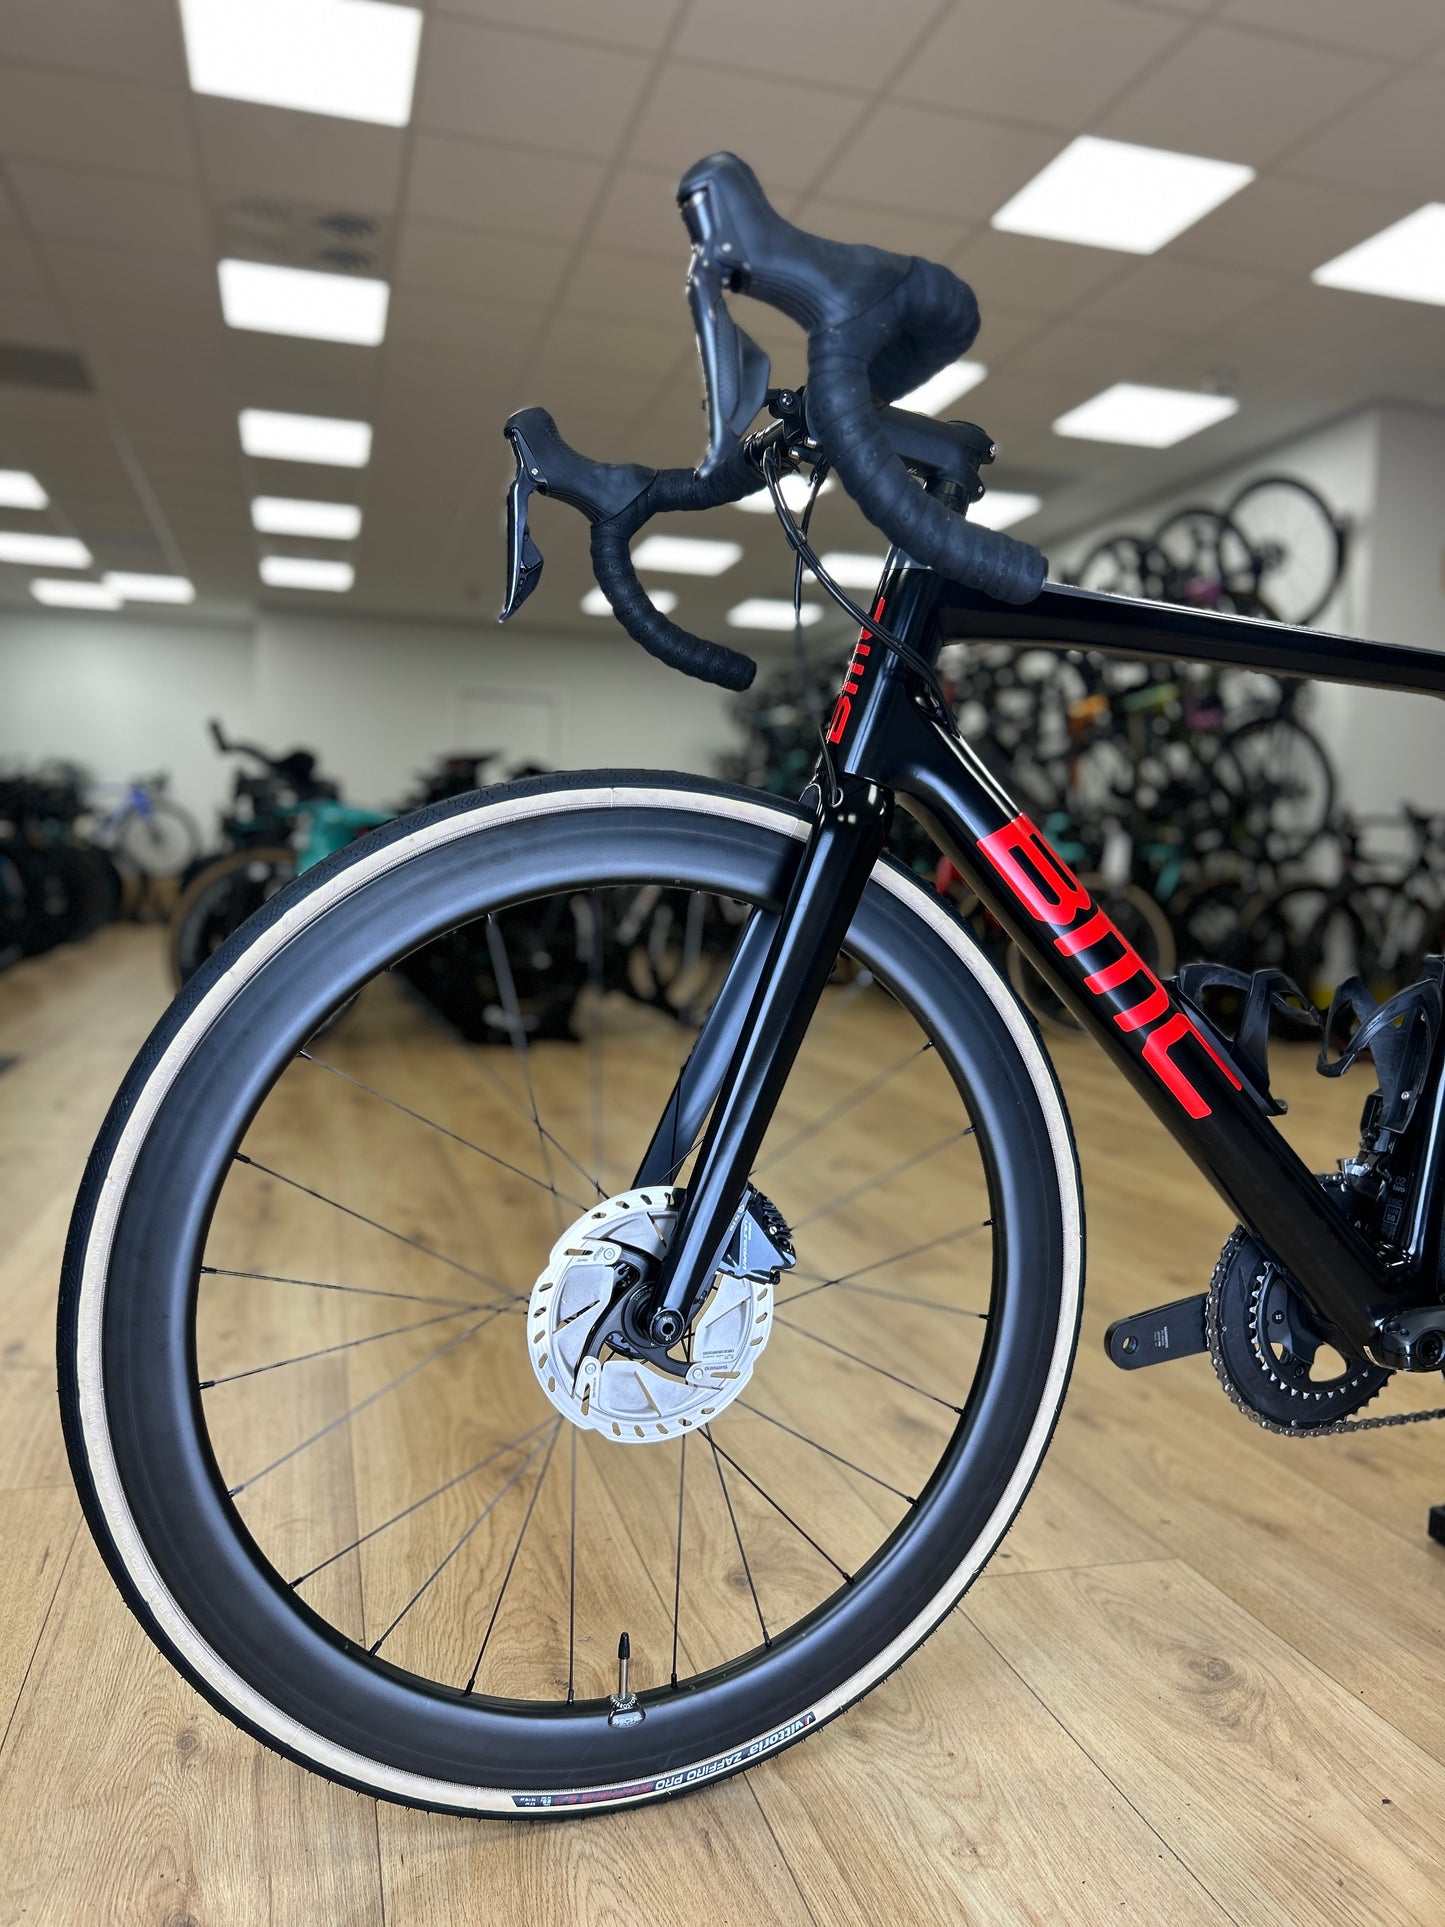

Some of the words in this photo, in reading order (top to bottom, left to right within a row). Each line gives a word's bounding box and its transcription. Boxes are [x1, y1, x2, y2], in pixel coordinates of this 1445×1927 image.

[977, 812, 1242, 1119] BMC
[687, 1752, 742, 1781] ZAFFIRO
[655, 1774, 684, 1791] PRO
